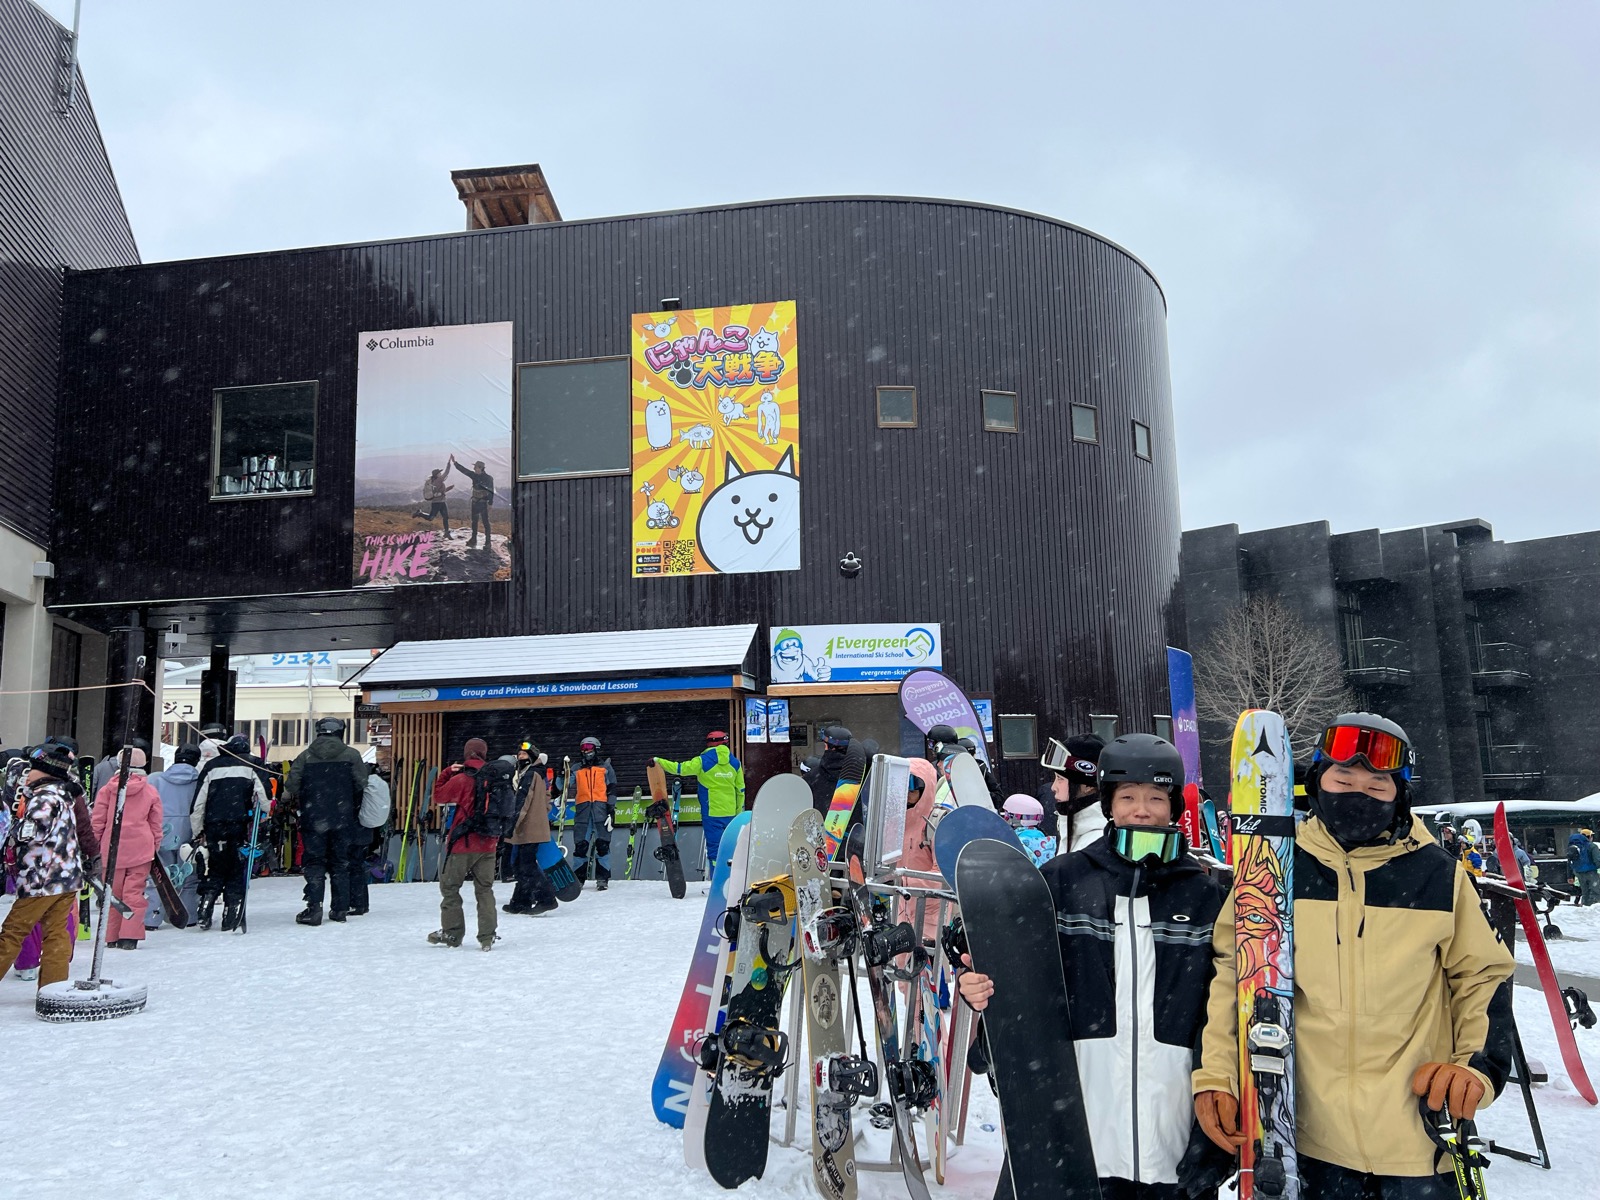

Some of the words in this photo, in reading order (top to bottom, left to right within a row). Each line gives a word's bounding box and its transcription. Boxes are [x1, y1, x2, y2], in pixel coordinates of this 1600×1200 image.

[379, 336, 434, 349] Columbia
[645, 326, 749, 373] にゃんこ
[694, 351, 784, 388] 大戦争
[365, 535, 386, 546] THIS
[387, 534, 396, 545] IS
[397, 531, 419, 544] WHY
[420, 531, 436, 543] WE
[360, 543, 435, 579] HIKE
[837, 636, 908, 652] Evergreen
[271, 652, 331, 666] ジュネス
[461, 688, 486, 697] Group
[488, 687, 503, 695] and
[505, 686, 535, 694] Private
[537, 684, 549, 693] Ski
[551, 684, 558, 692] &
[559, 682, 605, 692] Snowboard
[607, 681, 638, 690] Lessons
[1232, 815, 1262, 831] Vail
